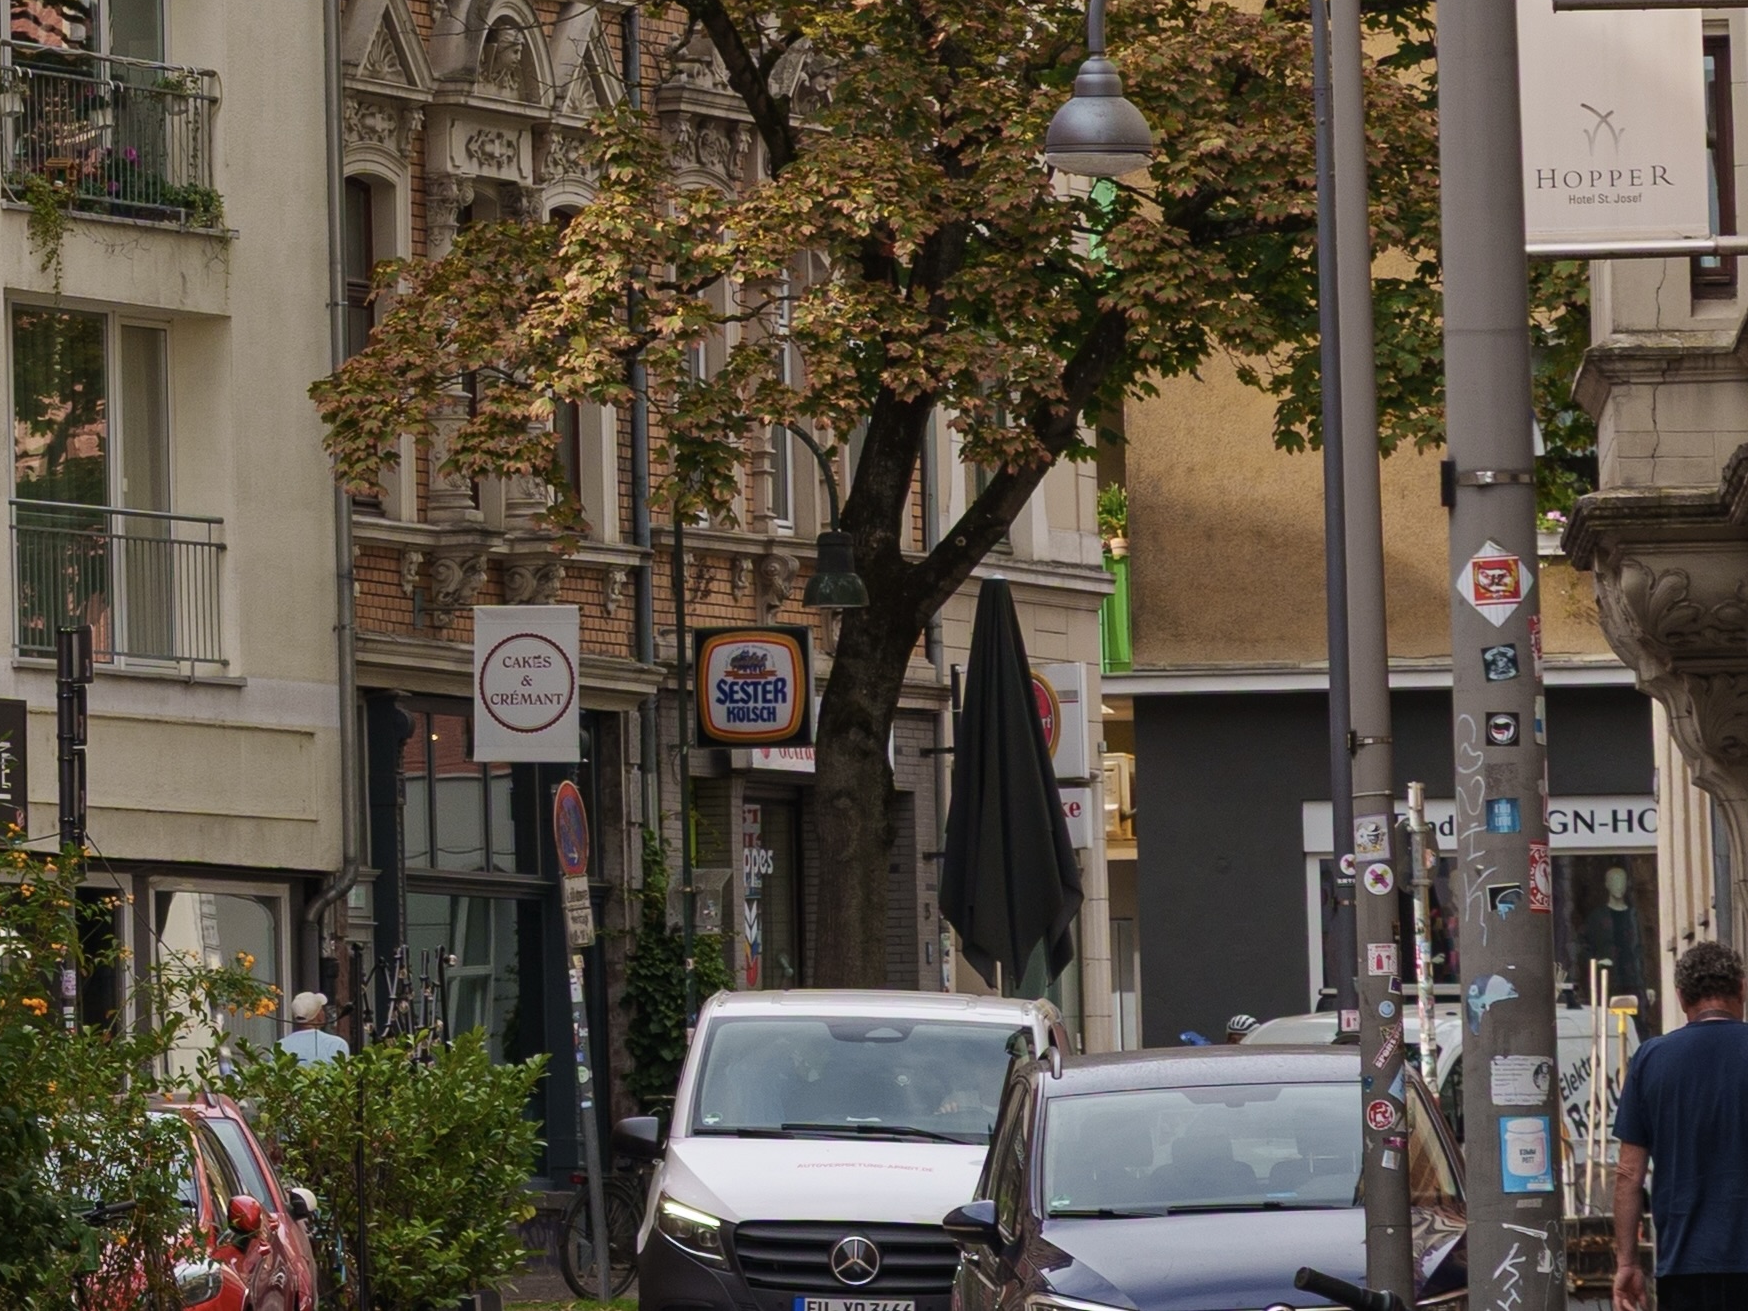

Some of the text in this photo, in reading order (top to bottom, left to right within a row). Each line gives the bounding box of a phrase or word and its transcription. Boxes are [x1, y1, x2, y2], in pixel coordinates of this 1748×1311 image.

[1536, 164, 1675, 189] HOPPER
[1568, 192, 1642, 205] Hotel St. Josef
[502, 654, 552, 669] CAKES
[520, 674, 533, 687] &
[490, 689, 564, 706] CRÉMANT
[715, 676, 788, 706] SESTER
[726, 706, 777, 723] KÖLSCH
